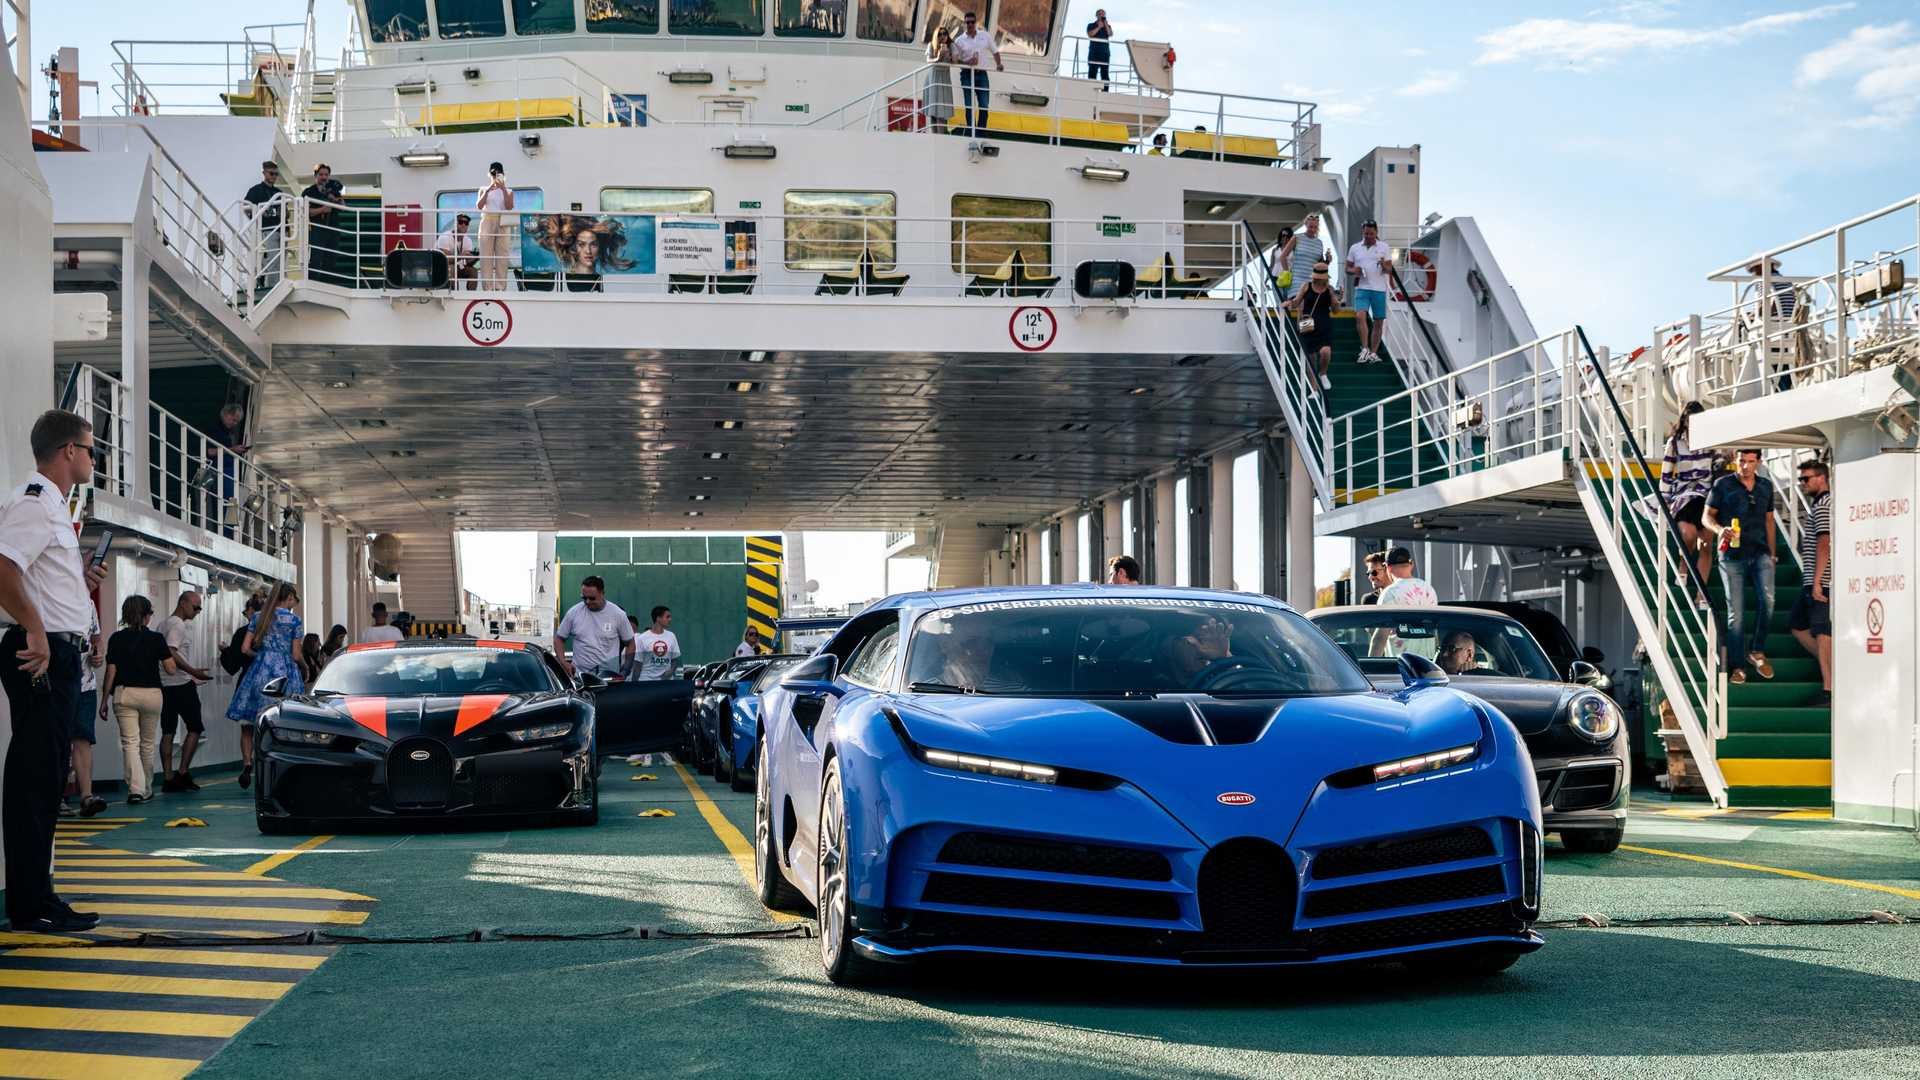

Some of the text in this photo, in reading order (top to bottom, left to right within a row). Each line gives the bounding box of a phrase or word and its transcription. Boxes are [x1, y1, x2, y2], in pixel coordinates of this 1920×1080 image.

[472, 312, 503, 330] 5,0m
[1849, 498, 1910, 522] ZABRANJENO
[543, 561, 551, 572] K
[1848, 574, 1905, 594] NO SMOKING
